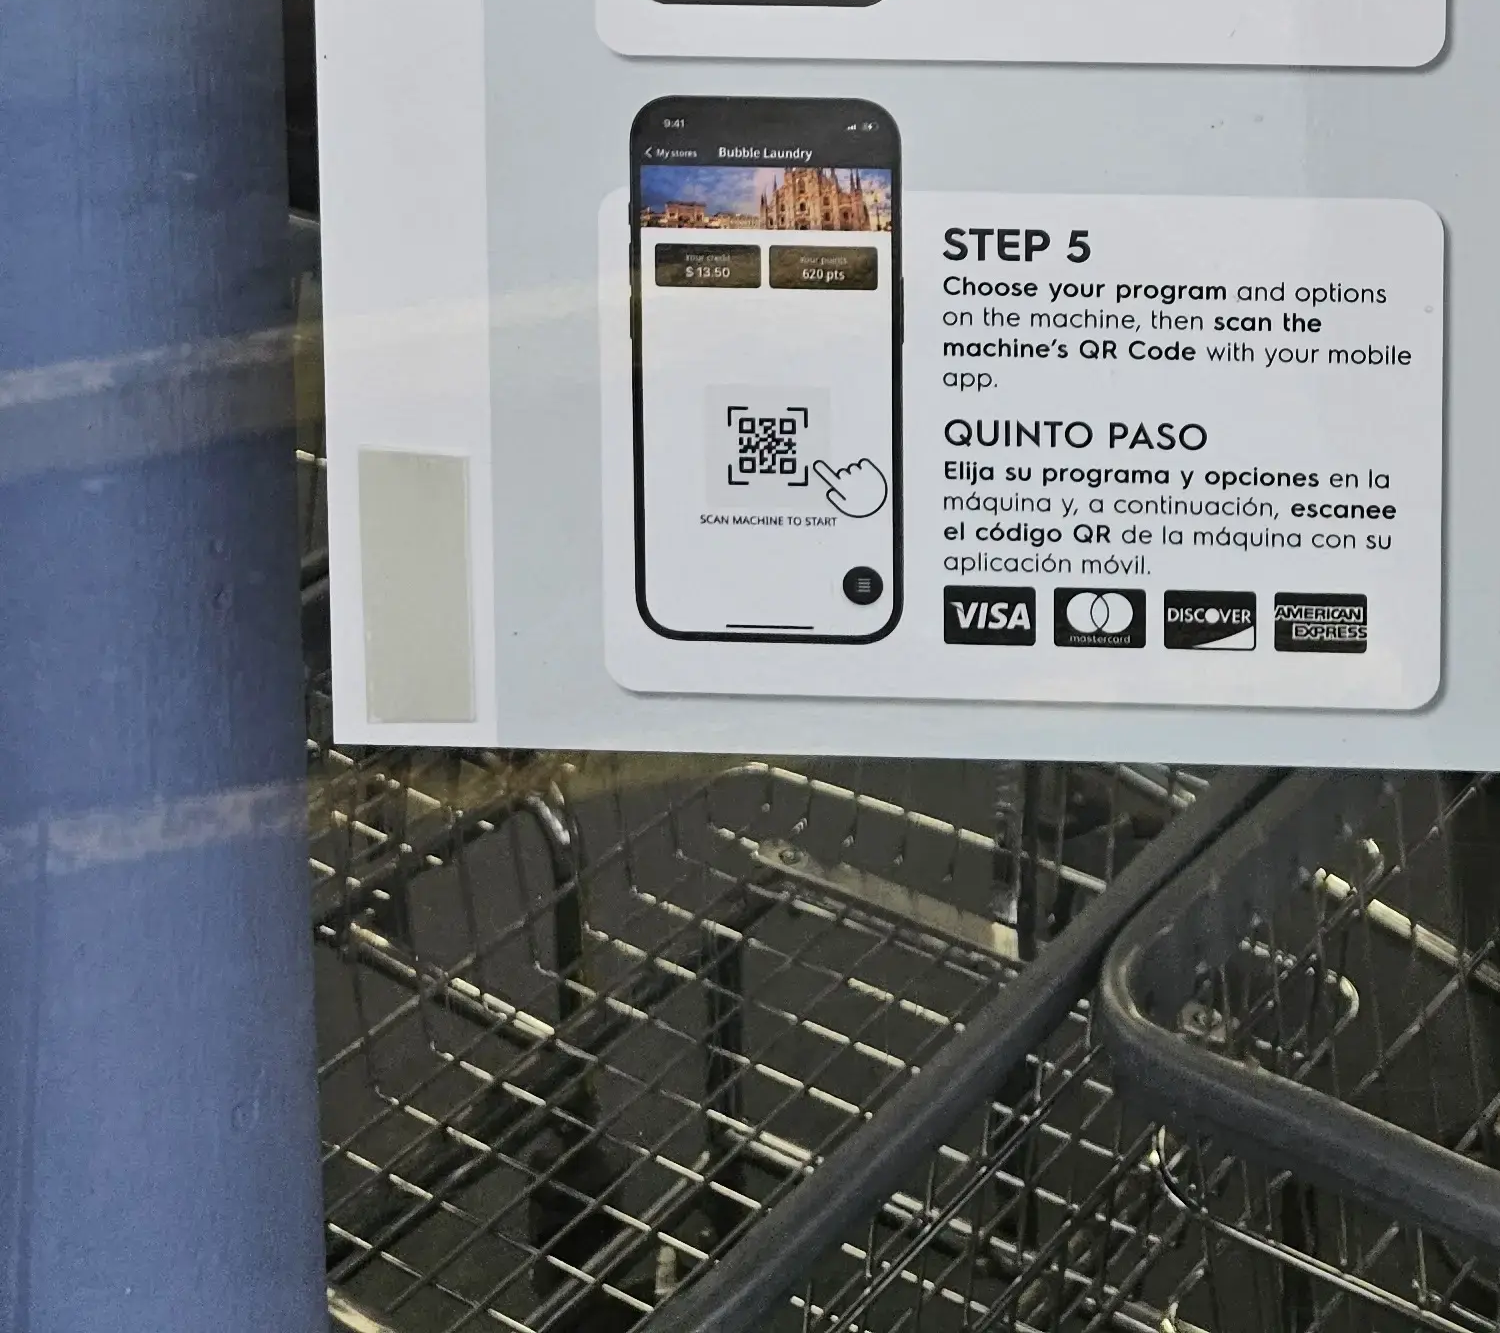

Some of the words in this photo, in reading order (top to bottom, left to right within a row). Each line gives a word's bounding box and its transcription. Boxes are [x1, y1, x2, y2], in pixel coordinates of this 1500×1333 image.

[943, 227, 1050, 262] STEP
[1067, 230, 1091, 263] 5
[802, 269, 824, 279] 620
[826, 270, 845, 282] pts
[943, 276, 1038, 297] Choose
[1049, 283, 1105, 302] your
[1116, 284, 1226, 305] program
[1237, 282, 1284, 301] and
[1295, 283, 1387, 307] options
[944, 419, 1093, 448] QUINTO
[1109, 422, 1207, 451] PASO
[950, 601, 1031, 630] VISA
[1274, 604, 1363, 621] AMERICAN
[1069, 633, 1131, 645] mastercard
[1292, 624, 1367, 640] EXPRESS
